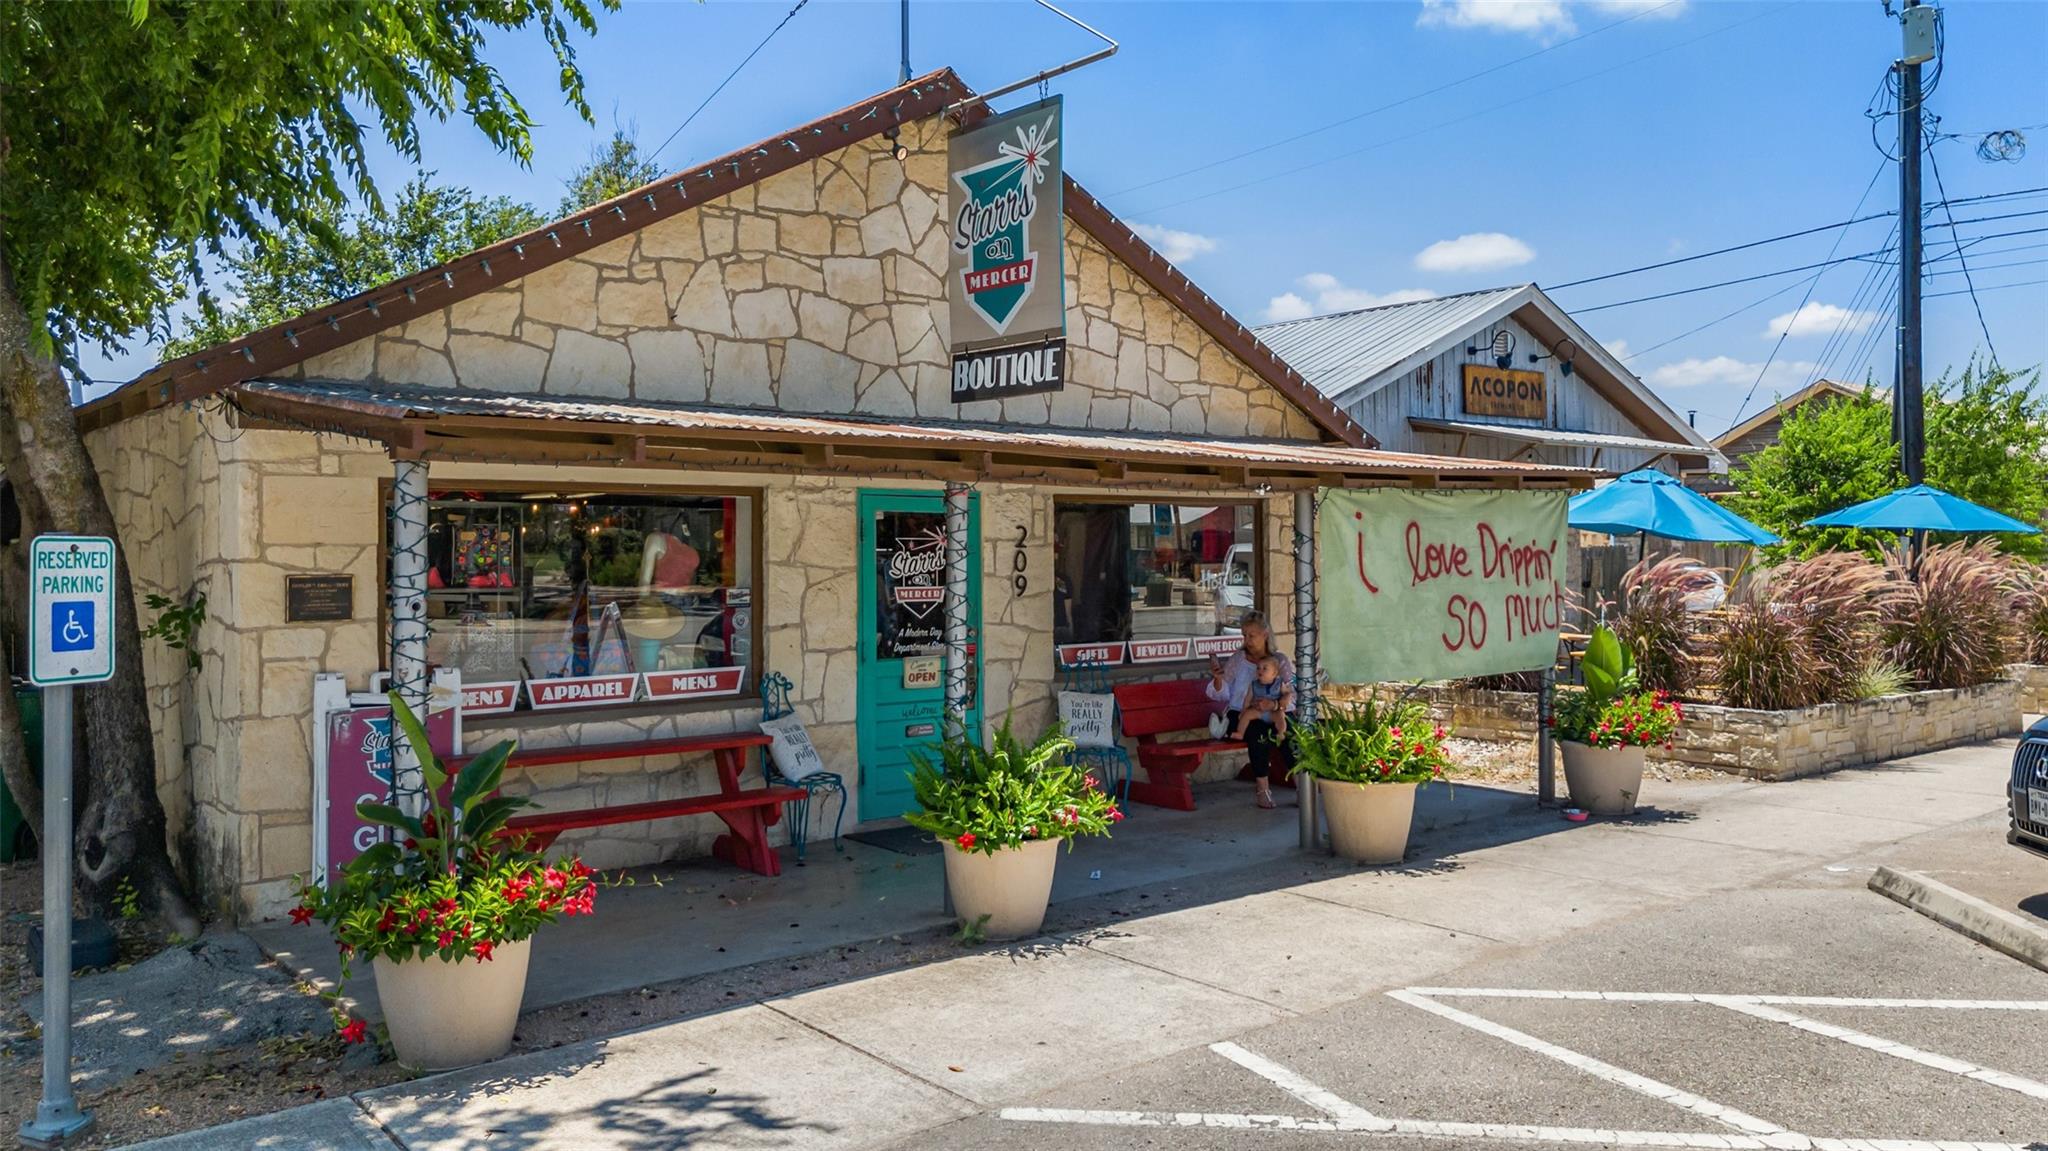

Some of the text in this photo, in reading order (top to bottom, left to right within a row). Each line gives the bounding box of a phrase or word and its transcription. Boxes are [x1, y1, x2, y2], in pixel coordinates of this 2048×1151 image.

[954, 185, 1034, 250] Starrs
[986, 237, 1014, 260] on
[969, 264, 1029, 290] MERCER
[954, 347, 1061, 392] BOUTIQUE
[1471, 375, 1542, 400] ACOPON
[38, 551, 109, 569] RESERVED
[1015, 525, 1027, 597] 209
[1405, 521, 1473, 587] love
[889, 549, 946, 578] Starrs
[42, 576, 104, 594] PARKING
[900, 589, 941, 599] MERCER
[929, 626, 943, 641] Day
[1077, 647, 1109, 661] GIFTS
[1136, 643, 1184, 657] JEWELRY
[1198, 640, 1244, 653] HOME DECO
[672, 674, 718, 691] MENS
[908, 672, 936, 683] OPEN
[541, 681, 624, 702] APPAREL
[1072, 709, 1103, 719] REALLY
[1070, 721, 1101, 737] pretty
